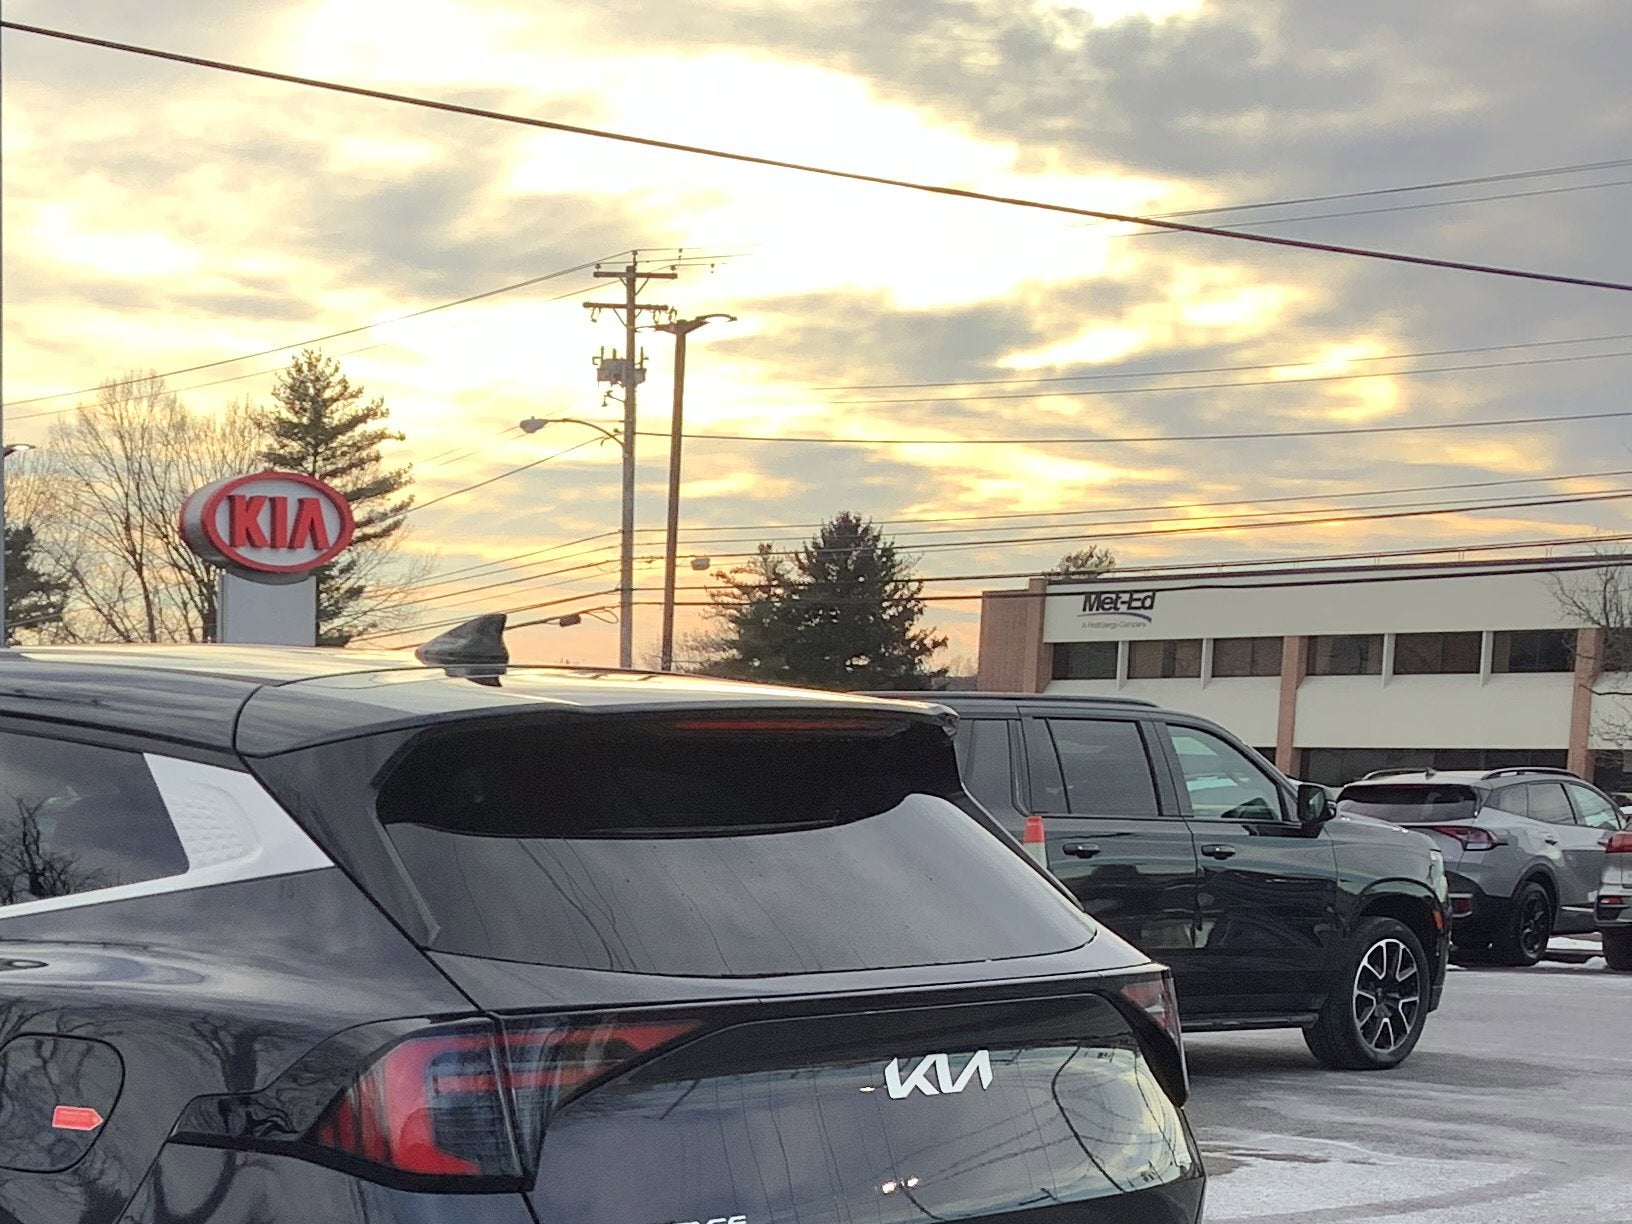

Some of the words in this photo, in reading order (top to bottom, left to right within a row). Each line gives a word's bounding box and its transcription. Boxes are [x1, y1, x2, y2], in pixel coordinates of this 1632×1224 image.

[227, 495, 330, 550] KIA
[1082, 591, 1156, 612] Met-Ed
[884, 1049, 994, 1100] KIA
